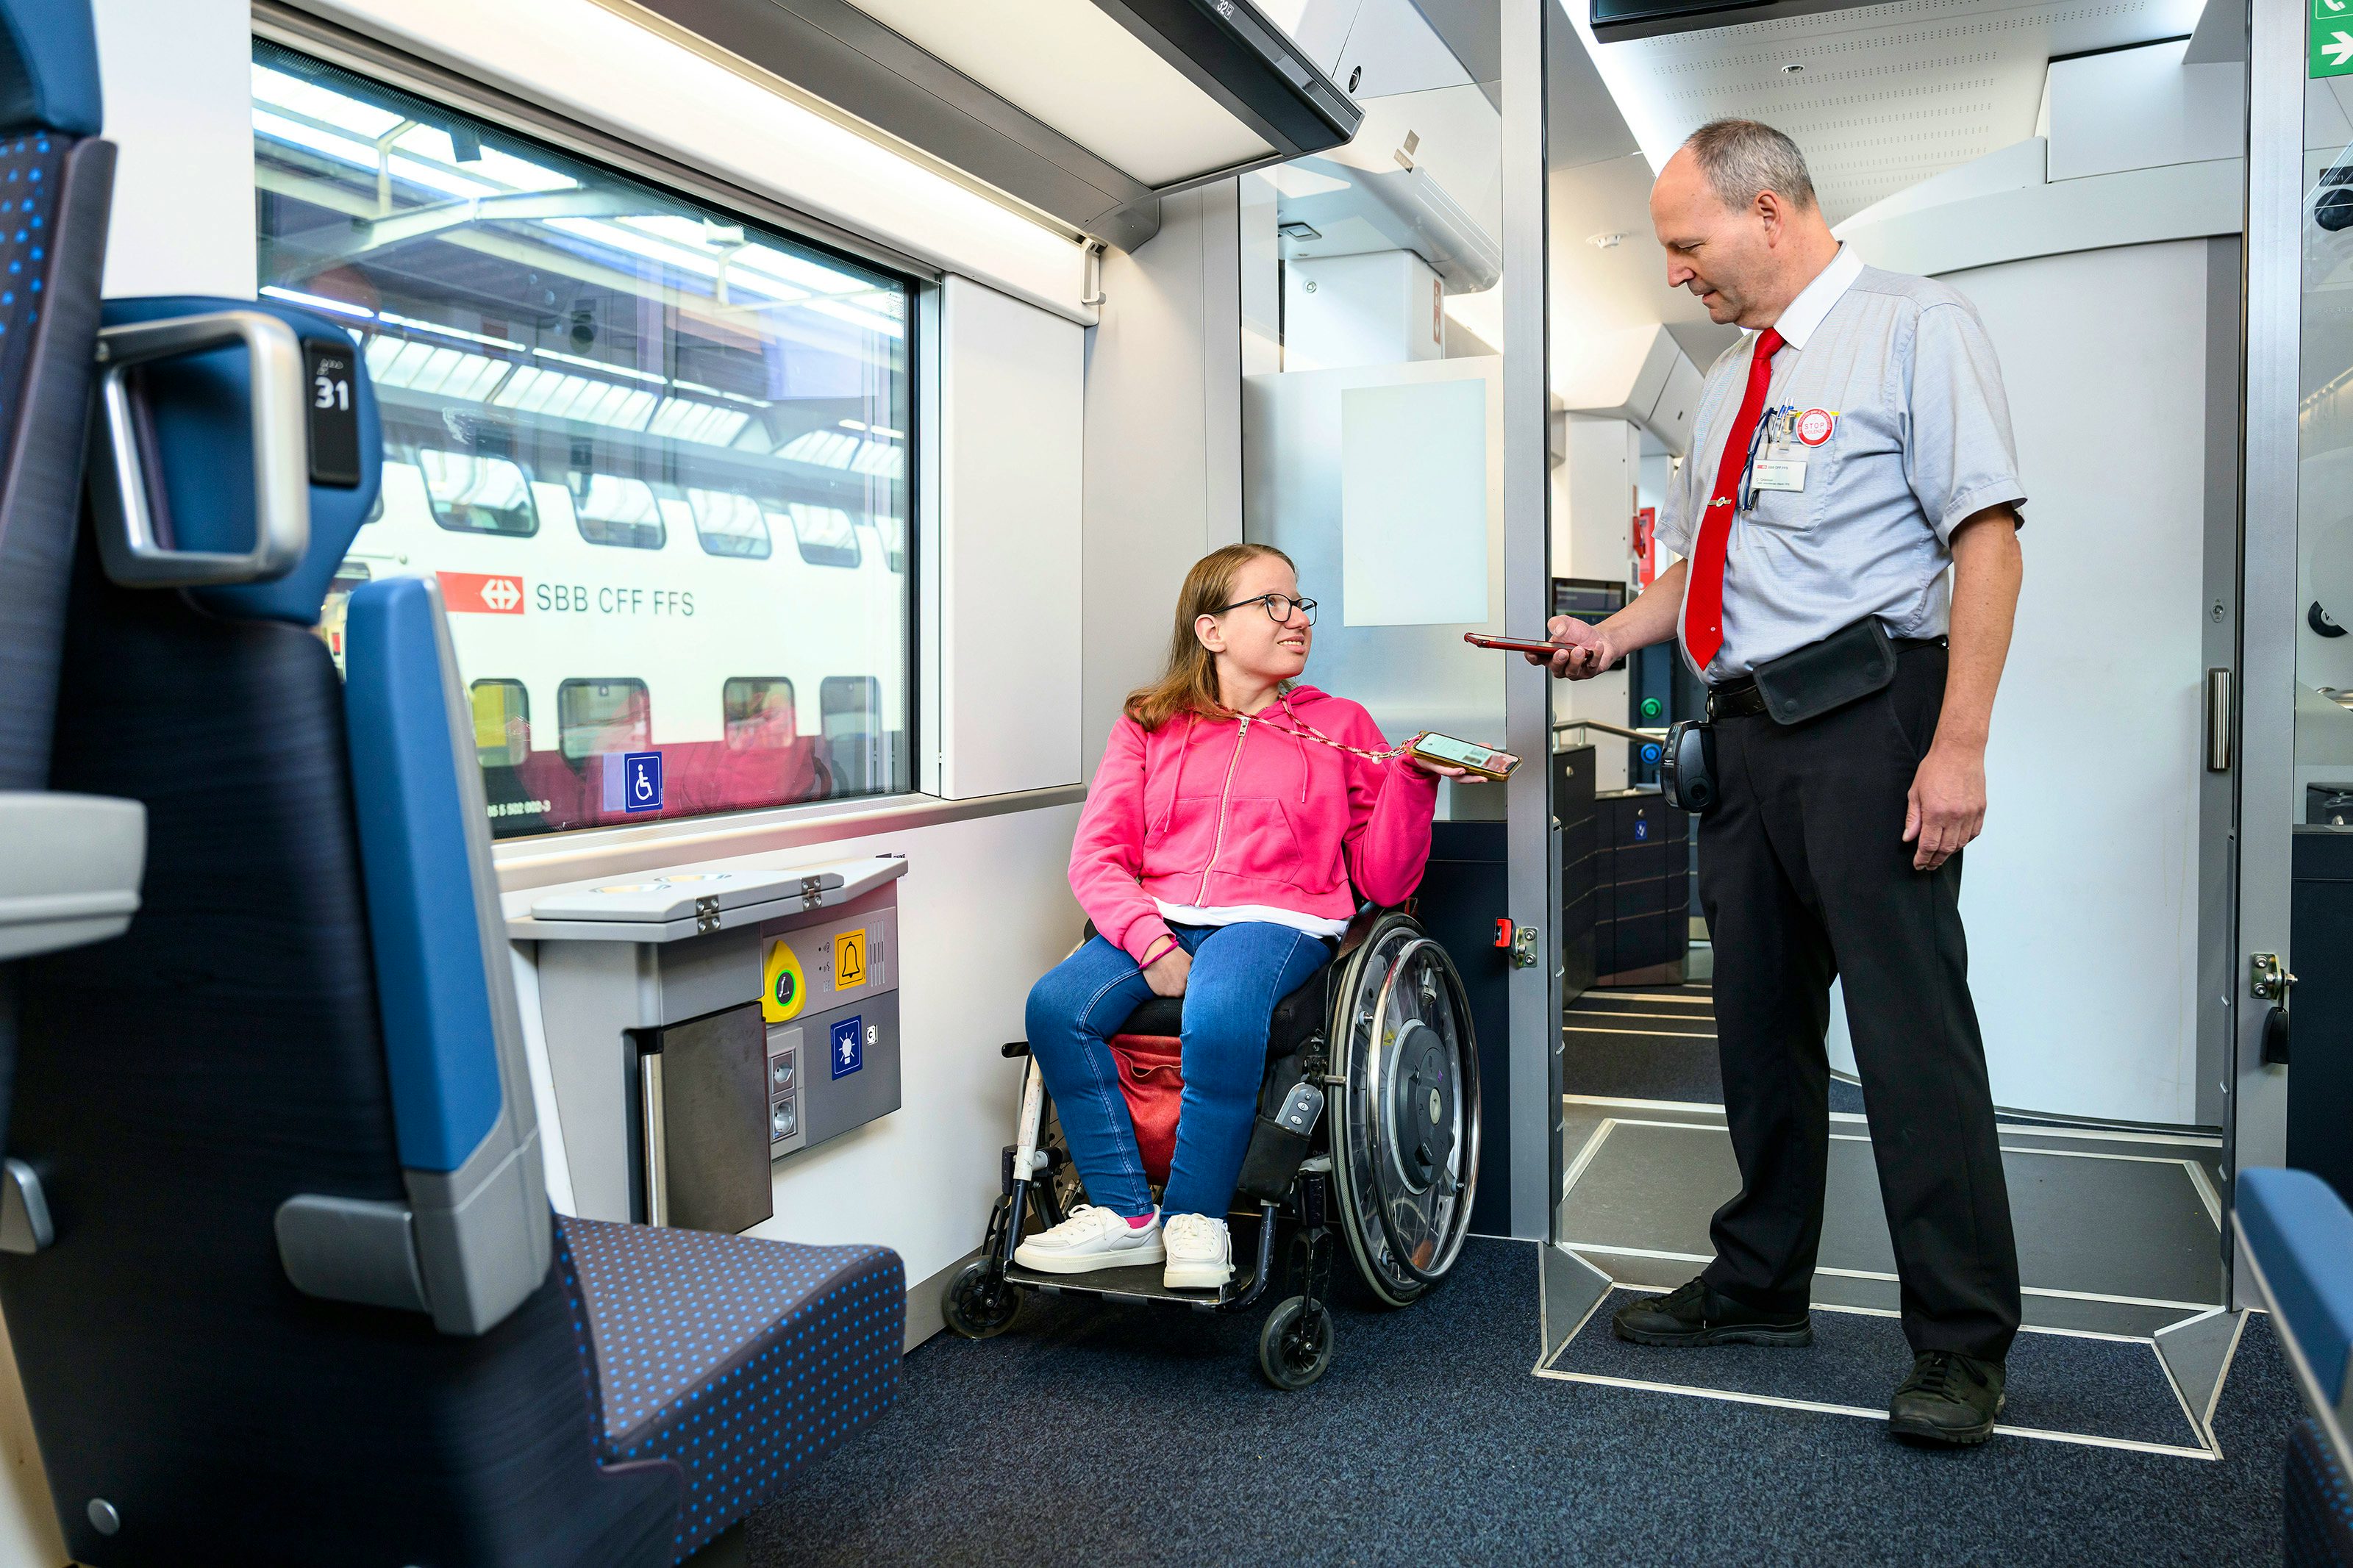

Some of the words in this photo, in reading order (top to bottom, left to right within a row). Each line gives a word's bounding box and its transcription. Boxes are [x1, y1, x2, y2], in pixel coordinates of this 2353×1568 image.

[1217, 0, 1228, 15] 32
[315, 376, 349, 411] 31
[537, 584, 588, 612] SBB
[599, 587, 643, 613] CFF
[654, 591, 694, 616] FFS
